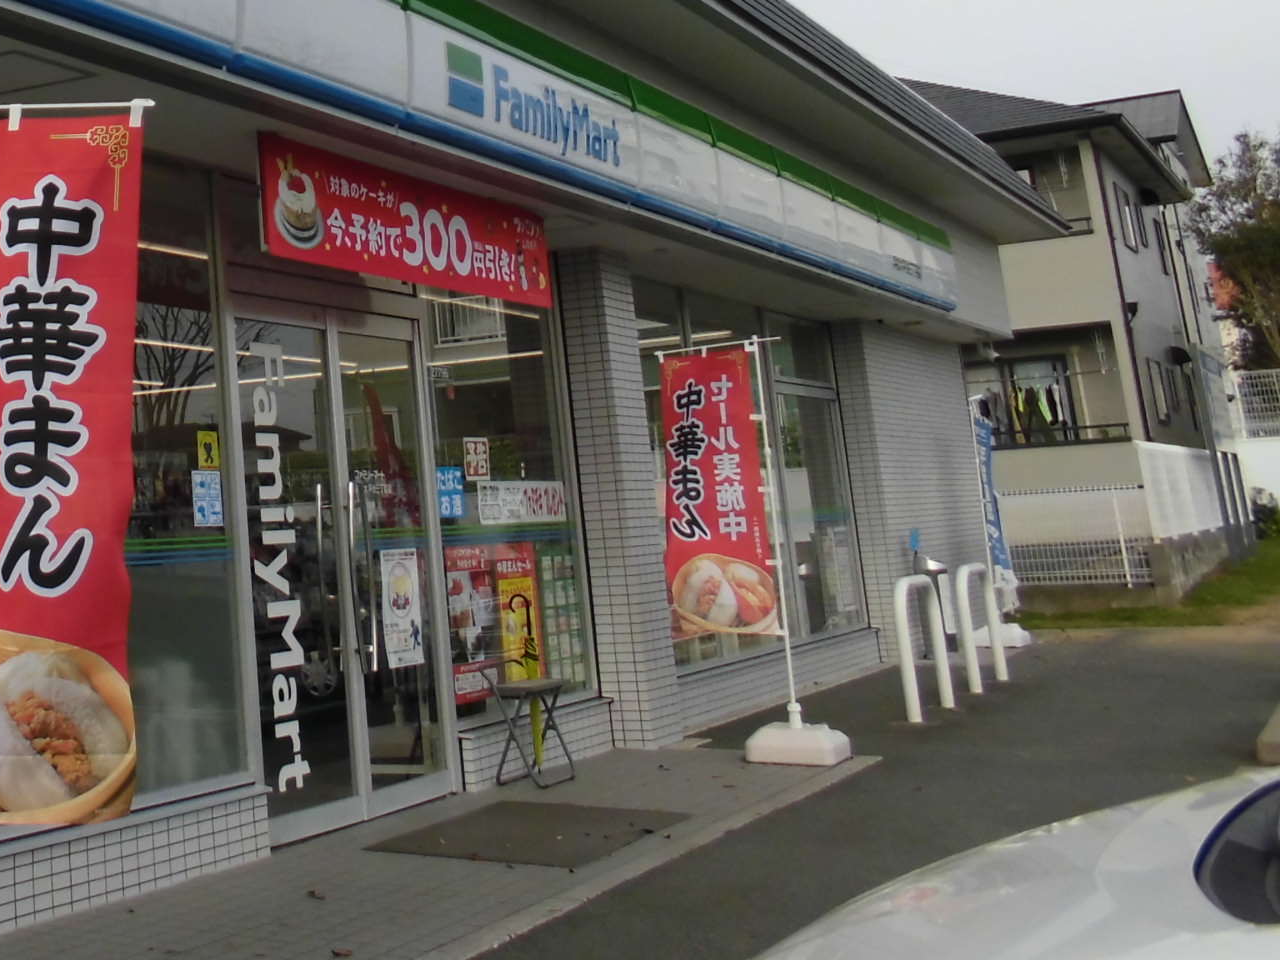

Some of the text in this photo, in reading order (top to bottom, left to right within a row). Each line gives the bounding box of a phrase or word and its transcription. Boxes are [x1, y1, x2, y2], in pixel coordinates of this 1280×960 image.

[493, 64, 620, 167] FamilyMart
[329, 175, 395, 209] 対象のケーキが
[436, 469, 463, 490] たばこ
[440, 494, 463, 516] お酒
[249, 343, 311, 792] FamilyMart
